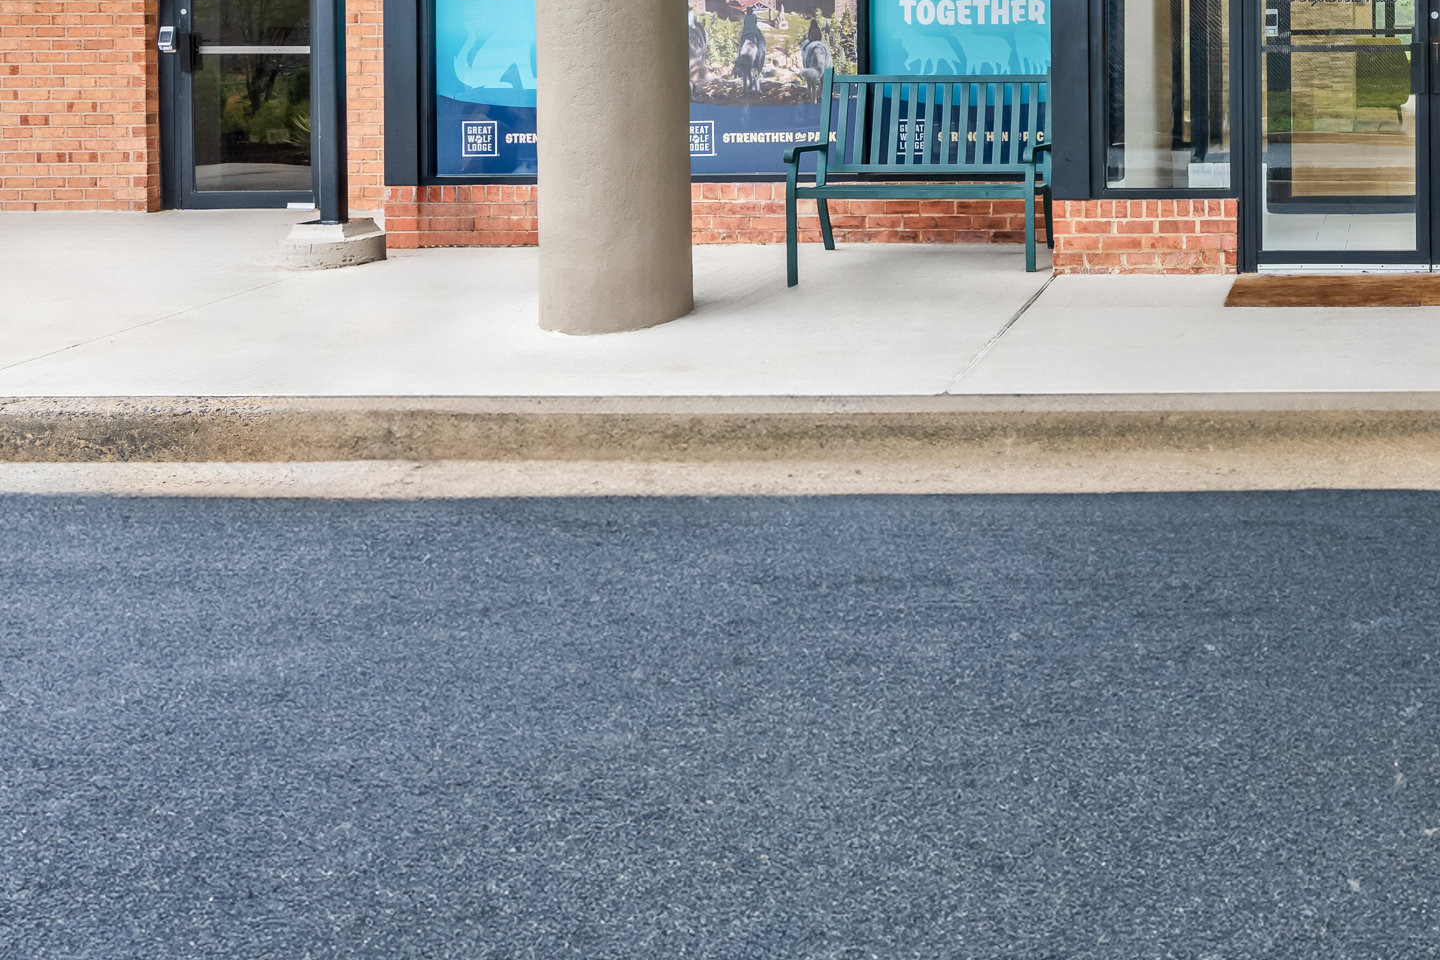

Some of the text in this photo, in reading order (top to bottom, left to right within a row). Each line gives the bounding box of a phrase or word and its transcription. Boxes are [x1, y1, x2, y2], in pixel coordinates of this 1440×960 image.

[899, 0, 1046, 25] TOGETHER
[467, 126, 492, 134] GREAT
[690, 126, 709, 134] REAT
[505, 133, 538, 144] STREN
[723, 131, 837, 143] STRENGTHEN the PAK
[467, 143, 492, 151] LODGE
[690, 143, 709, 151] ODGE
